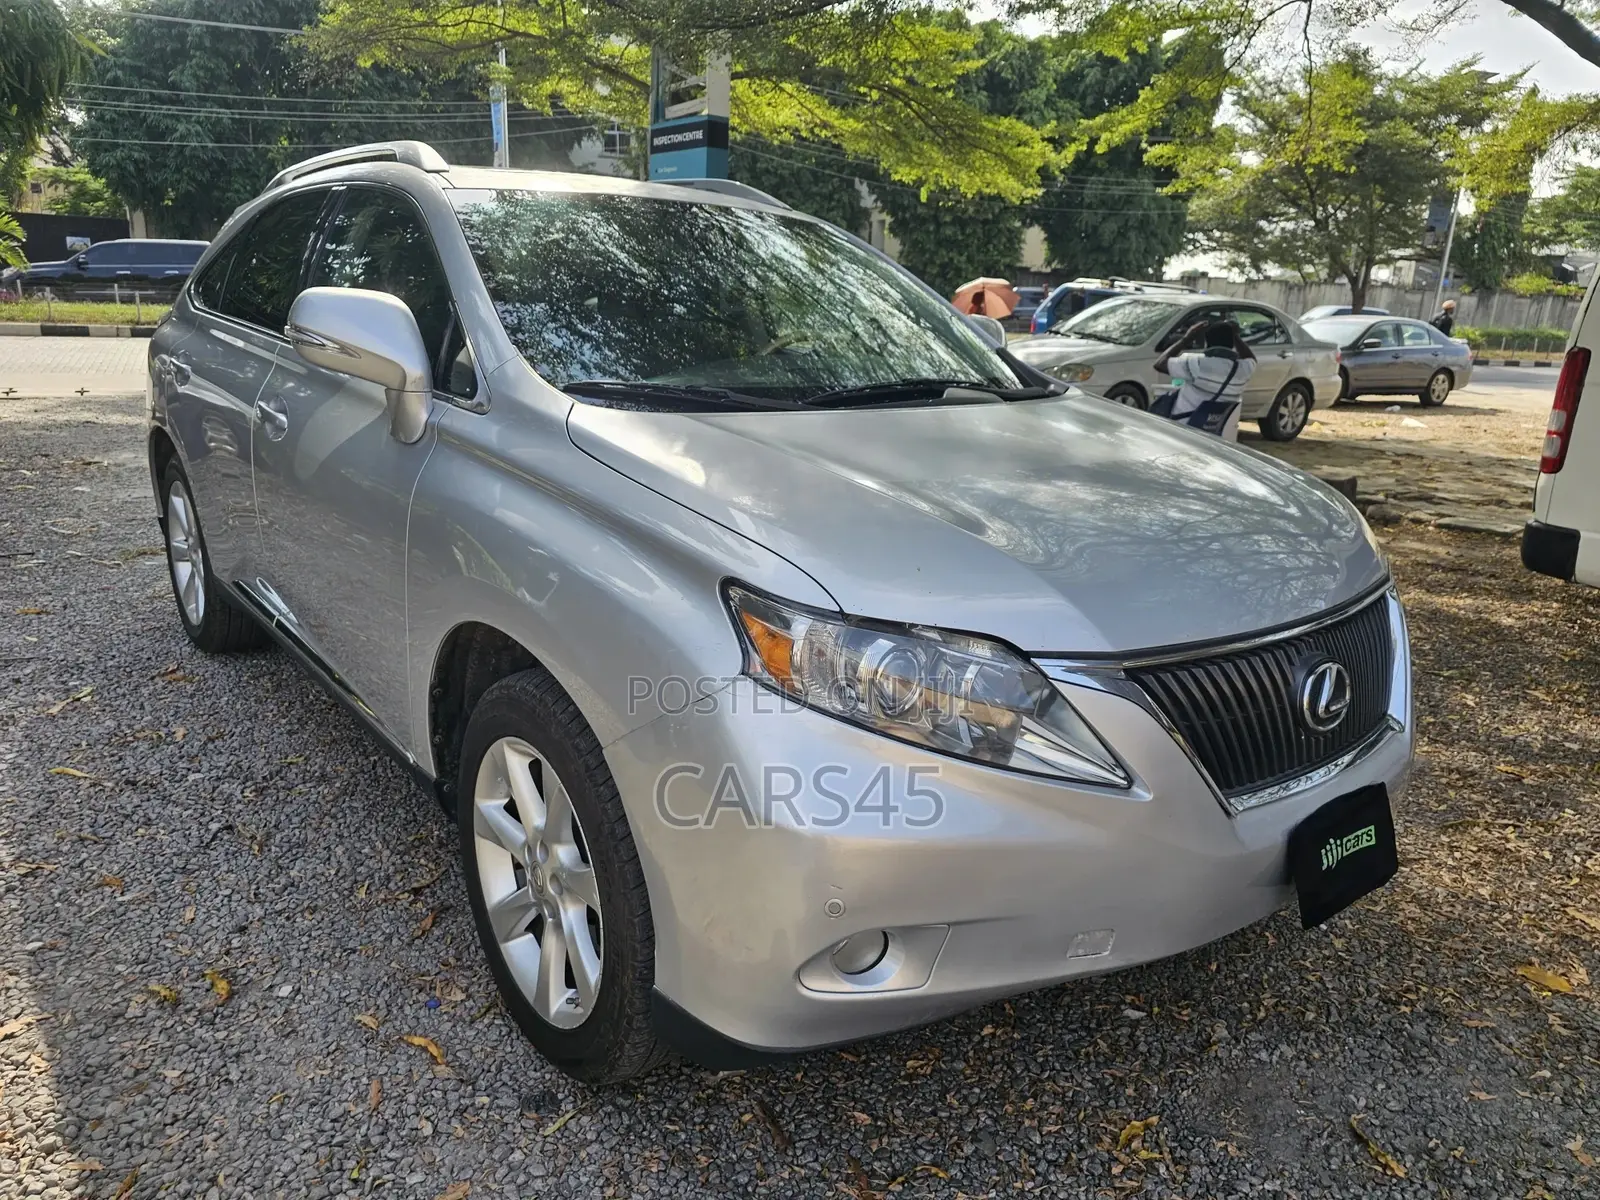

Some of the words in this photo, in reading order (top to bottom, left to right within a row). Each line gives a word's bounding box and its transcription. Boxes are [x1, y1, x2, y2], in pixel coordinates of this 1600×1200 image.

[653, 132, 683, 146] INSPECTION
[683, 129, 704, 142] CENTRE
[1343, 827, 1375, 854] cars
